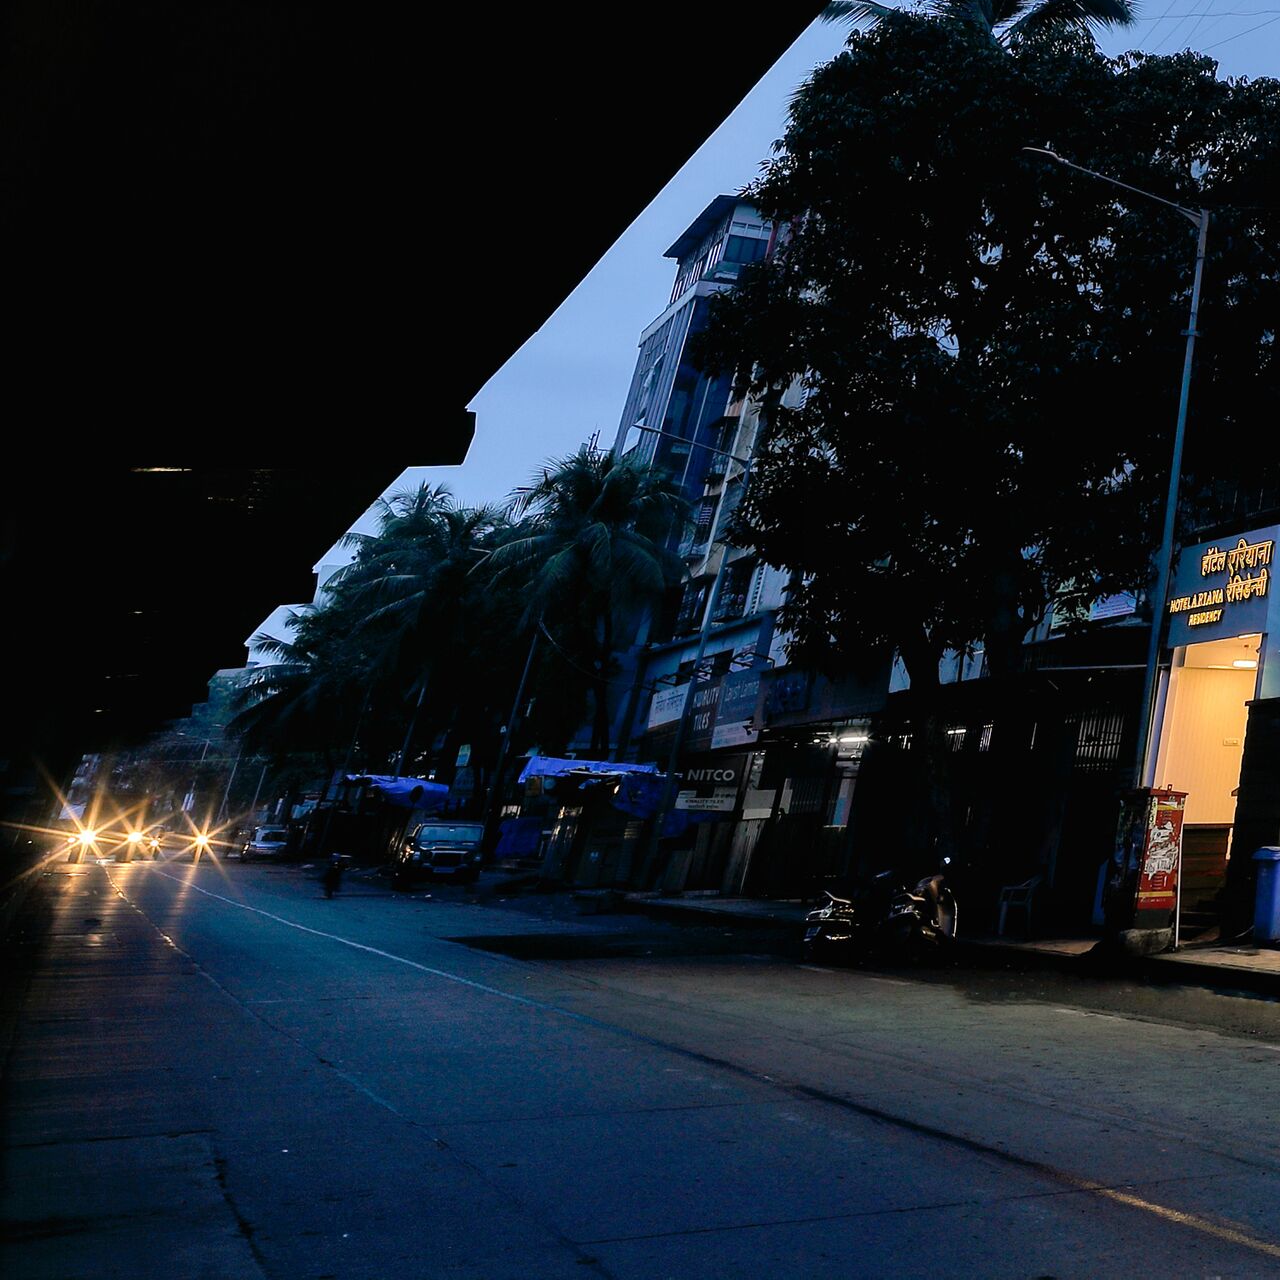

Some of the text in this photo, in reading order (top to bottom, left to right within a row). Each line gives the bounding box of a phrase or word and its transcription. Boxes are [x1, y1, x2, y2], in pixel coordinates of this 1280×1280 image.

[1201, 538, 1273, 576] हॉटेल एरियाना
[1226, 568, 1267, 602] रेसिडेन्सी
[1169, 589, 1224, 613] HOTEL ARIANA
[1188, 609, 1222, 626] RESIDENCY
[687, 769, 735, 782] NITCO
